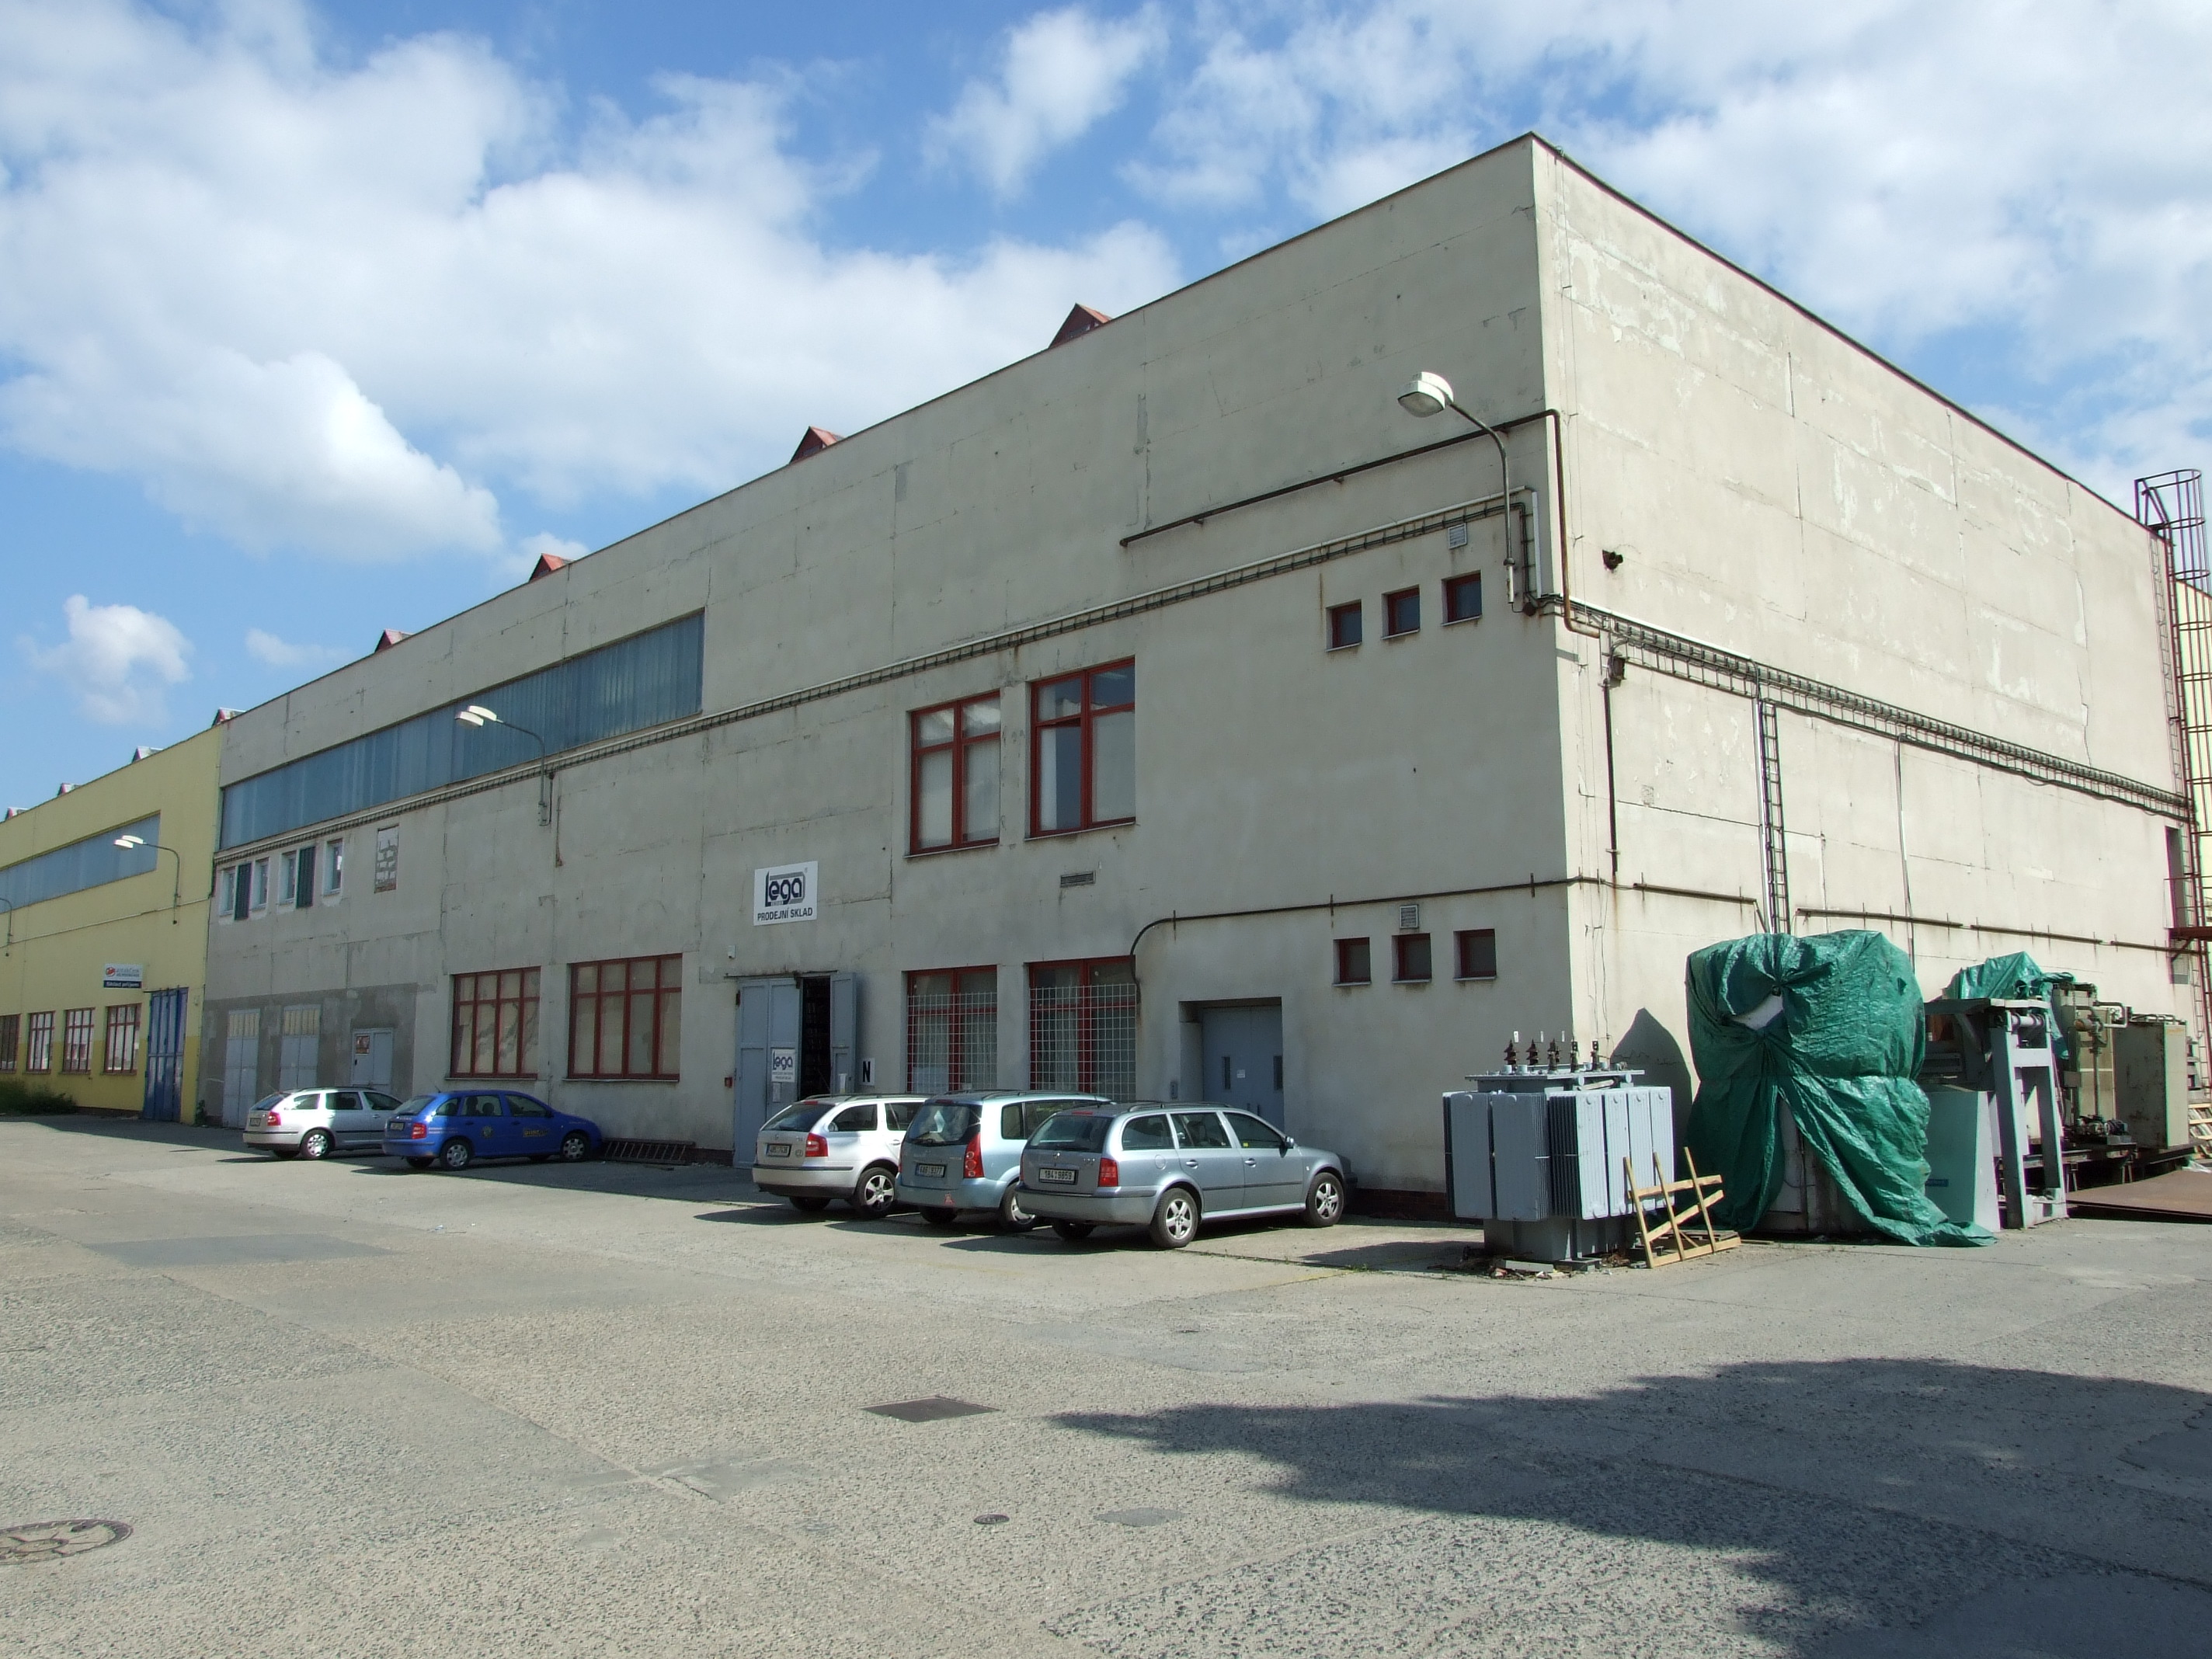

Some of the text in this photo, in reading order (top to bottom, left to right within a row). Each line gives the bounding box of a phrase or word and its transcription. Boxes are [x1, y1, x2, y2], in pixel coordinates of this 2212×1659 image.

[757, 907, 813, 921] PRODEJNÍ SKLAD
[863, 1061, 871, 1082] N
